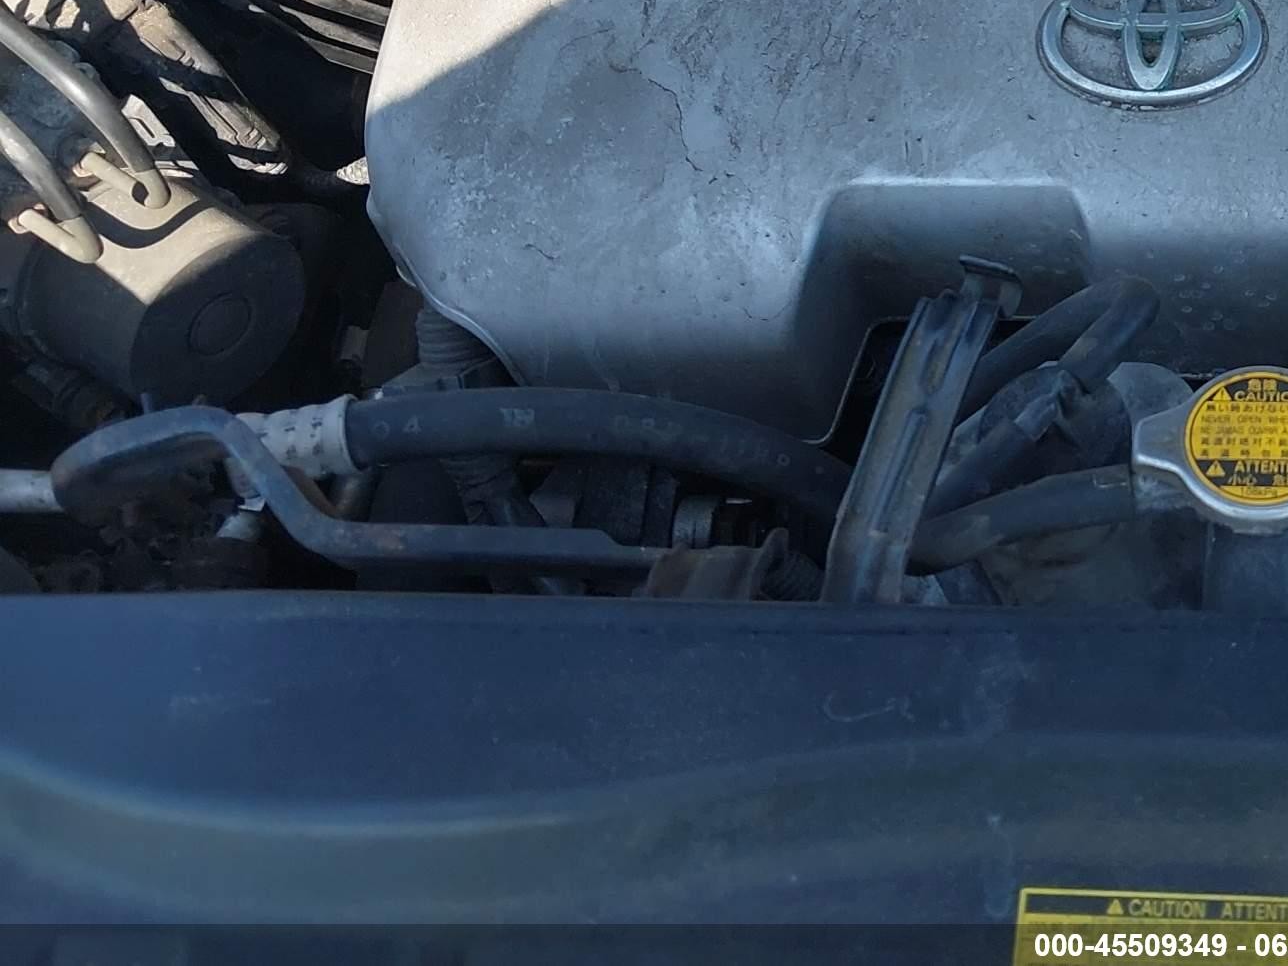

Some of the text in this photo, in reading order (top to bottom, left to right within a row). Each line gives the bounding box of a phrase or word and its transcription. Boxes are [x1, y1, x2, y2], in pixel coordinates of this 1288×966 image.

[1202, 415, 1231, 424] NEVER
[1237, 415, 1262, 424] OPEN
[1128, 899, 1206, 919] CAUTION
